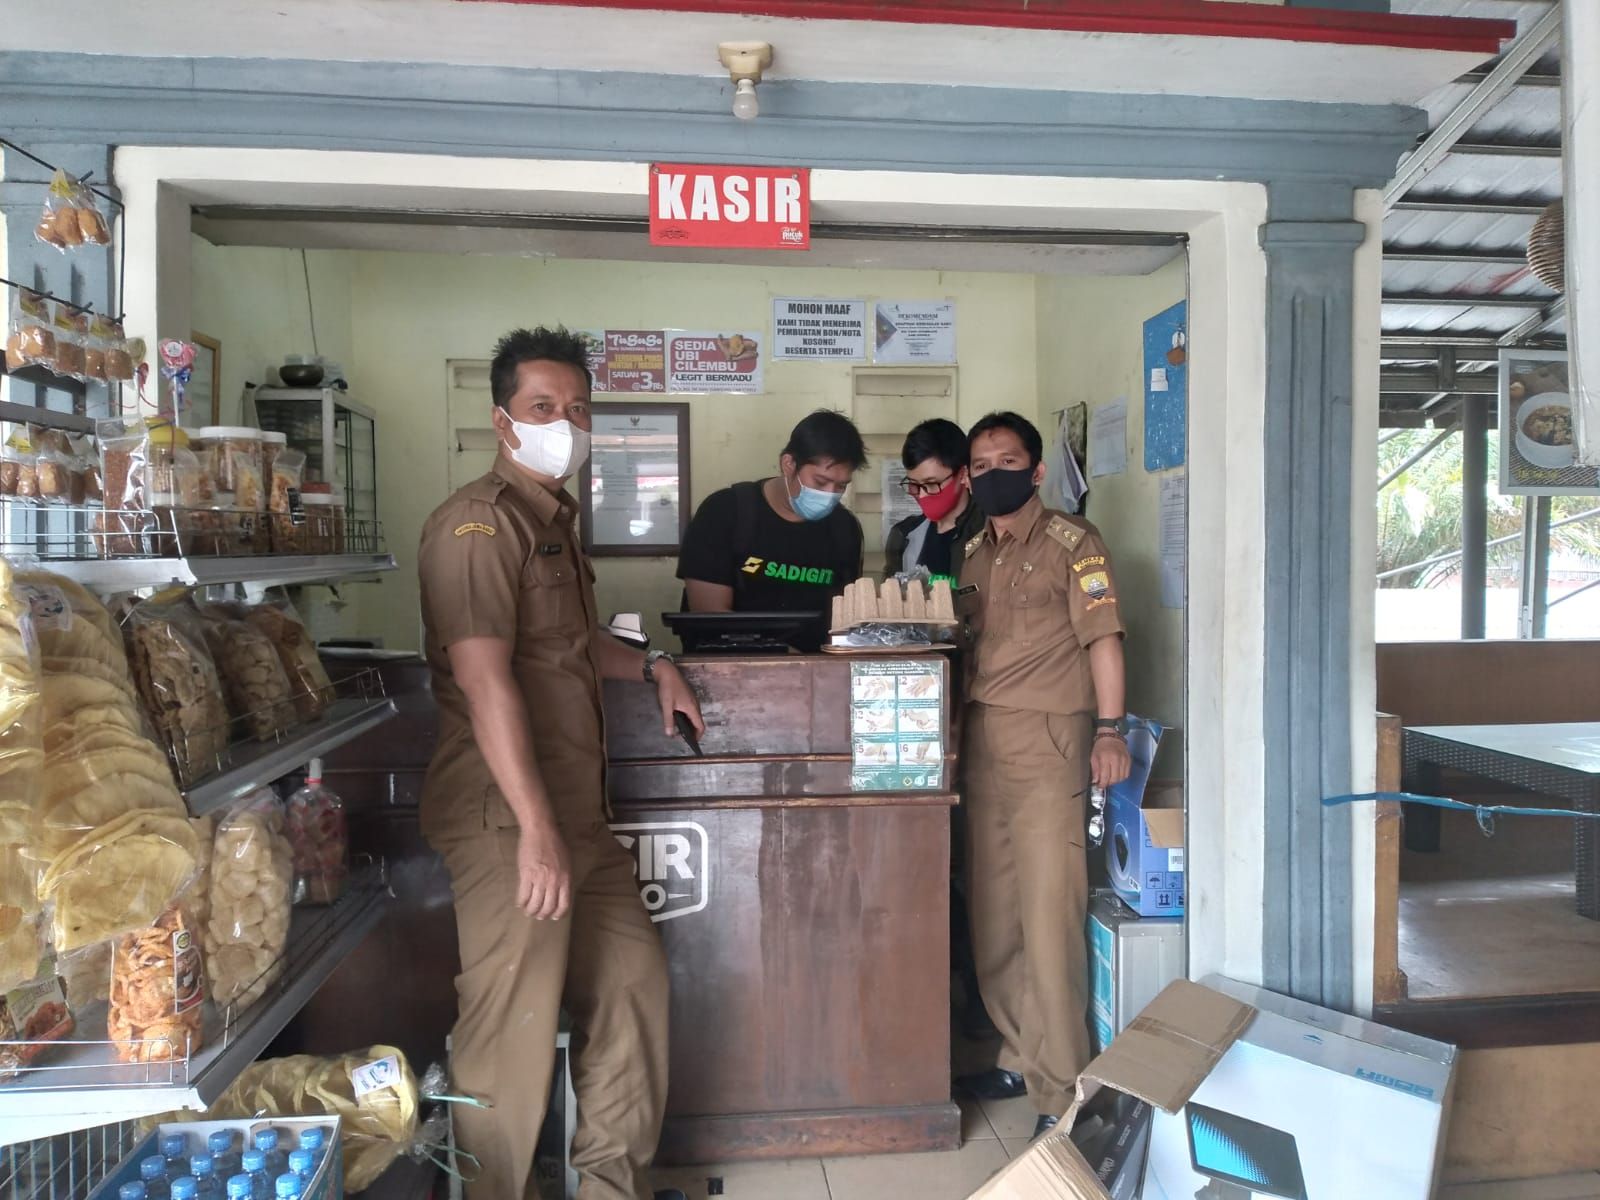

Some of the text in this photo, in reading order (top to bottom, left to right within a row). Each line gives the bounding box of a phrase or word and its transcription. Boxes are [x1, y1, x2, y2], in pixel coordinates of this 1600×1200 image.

[658, 173, 801, 223] KASIR
[788, 303, 851, 315] MOHON MAAF
[777, 319, 797, 327] KAMI
[822, 320, 861, 328] MENERIMA
[777, 328, 861, 337] PEMBUATAN BON/NOTA
[675, 340, 717, 351] SEDIA
[803, 338, 836, 346] KOSONG!
[675, 351, 699, 361] UBI
[785, 347, 854, 356] BESERTA STEMPEL!
[674, 361, 738, 371] CILEMBU
[675, 374, 752, 383] LEGIT BERMADU
[764, 561, 833, 585] SADIGIT
[902, 744, 909, 753] 6
